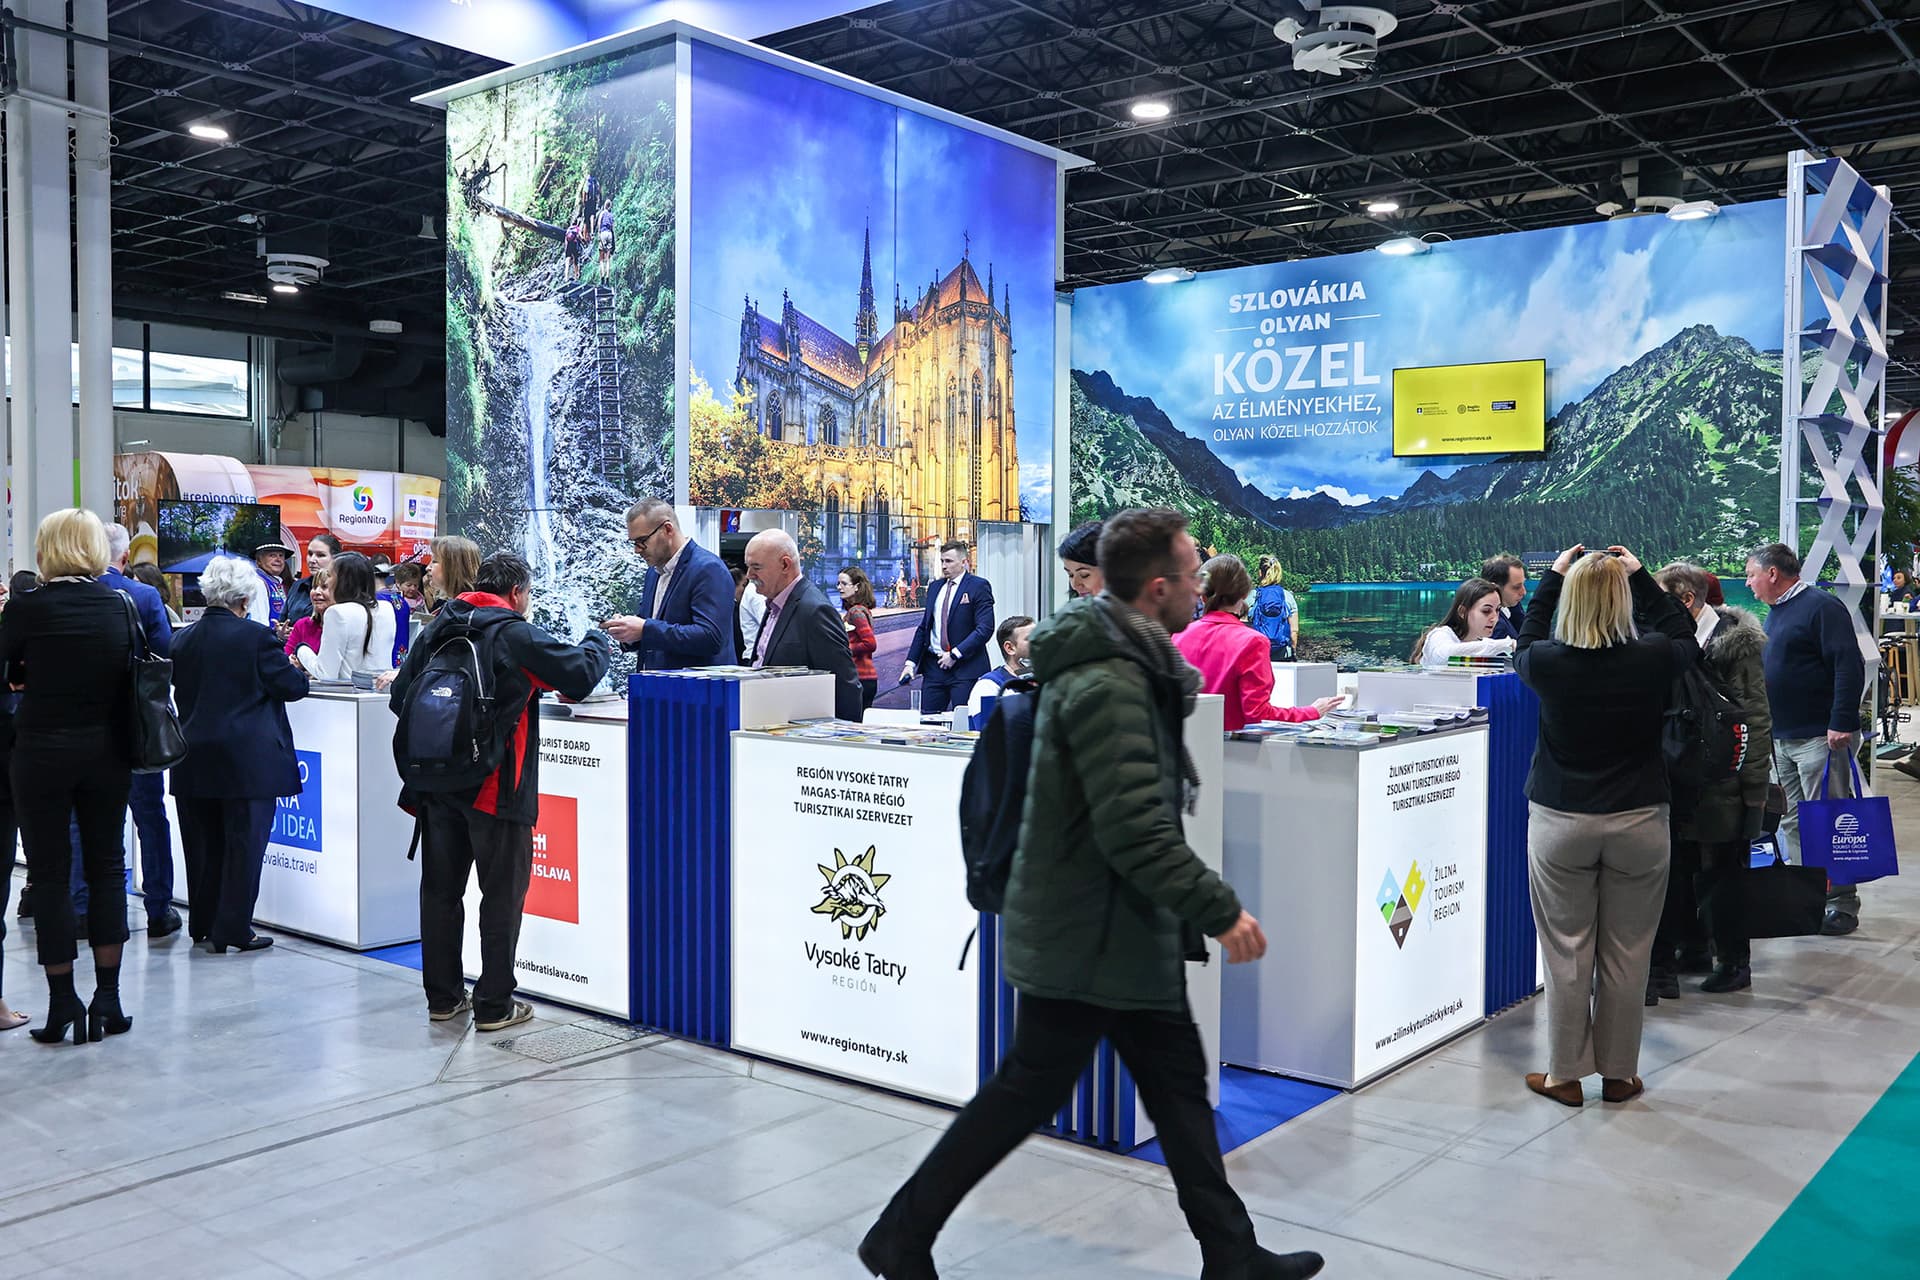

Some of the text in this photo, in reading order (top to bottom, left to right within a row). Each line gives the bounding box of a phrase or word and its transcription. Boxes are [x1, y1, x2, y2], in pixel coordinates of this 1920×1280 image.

[1229, 279, 1367, 314] SZLOVÁKIA
[1260, 312, 1331, 335] OLYAN
[1214, 336, 1381, 396] KÖZEL
[1212, 393, 1382, 421] AZ ÉLMÉNYEKHEZ,
[1213, 419, 1379, 442] OLYAN KÖZEL HOZZÁTOK
[563, 739, 590, 752] BOARD
[539, 752, 601, 768] TIKAI SZERVEZET
[1389, 753, 1460, 778] ŽILINSKÝ TURISTICKÝ KRAJ
[796, 766, 910, 789] REGIÓN VYSOKÉ TATRY
[1386, 768, 1461, 796] ZSOLNAI TURISZTIKAI RÉGIÓ
[800, 785, 905, 808] MAGAS-TÁTRA RÉGIÓ
[1392, 787, 1456, 812] TURISZTIKAI SZERVEZET
[793, 801, 913, 827] TURISZTIKAI SZERVEZET
[282, 813, 318, 841] IDEA
[262, 853, 318, 874] ovakia.travel
[531, 863, 572, 882] ISLAVA
[1434, 863, 1458, 882] ŽILINA
[1434, 879, 1465, 901] TOURISM
[1433, 900, 1461, 921] REGION
[514, 958, 589, 985] visitbratislava.com
[804, 940, 907, 986] Vysoké Tatry
[831, 973, 878, 994] REGIÓN
[1375, 997, 1464, 1050] www.zilinskyturistickykraj.sk
[800, 1029, 909, 1064] www.regiontatry.sk
